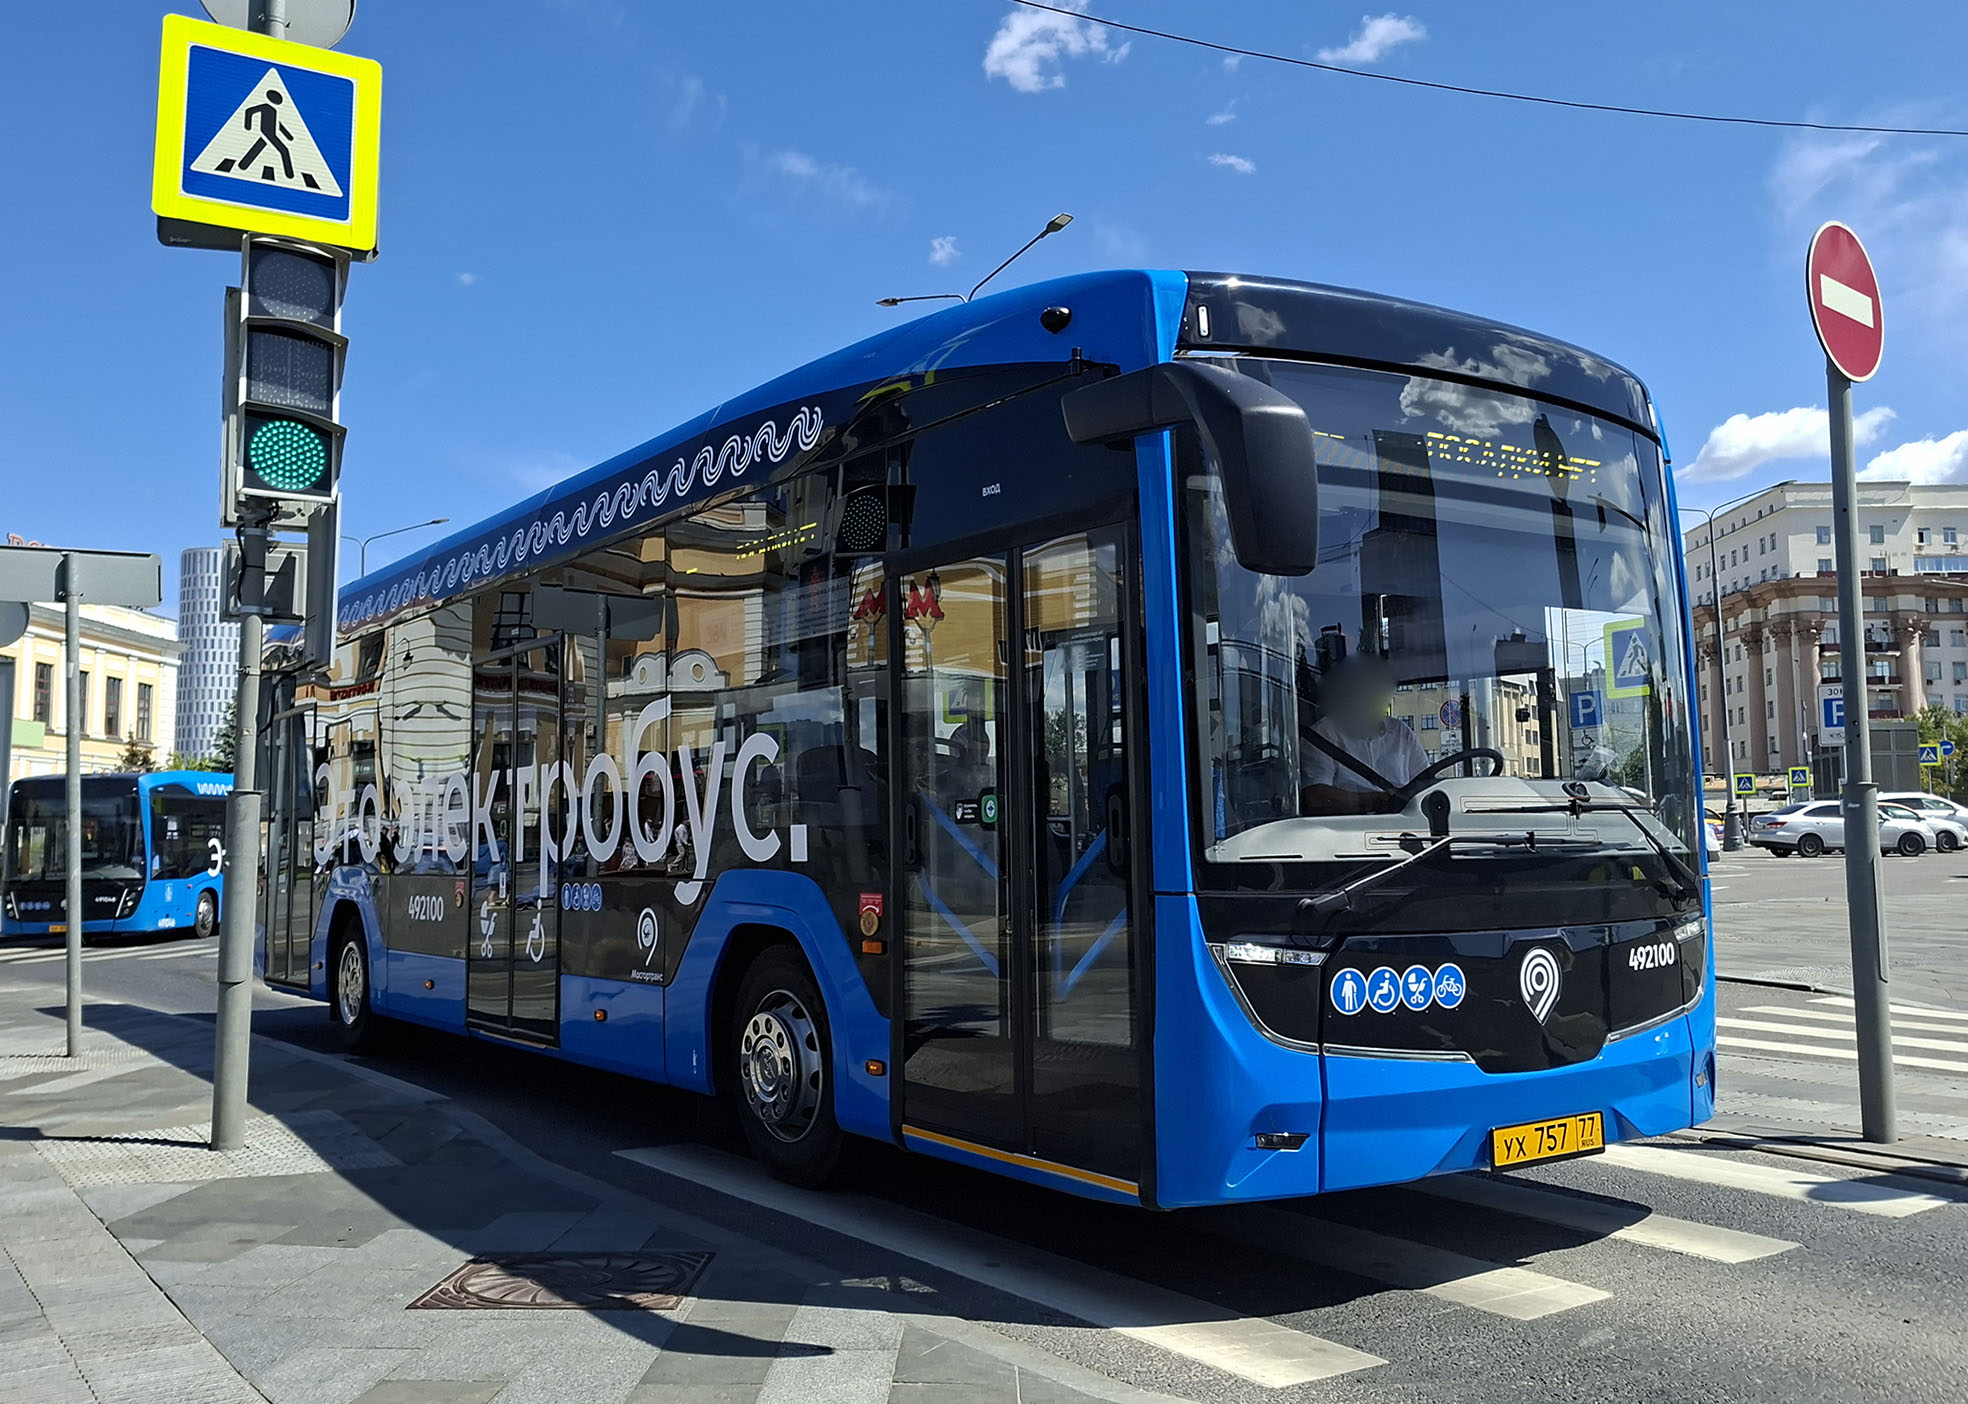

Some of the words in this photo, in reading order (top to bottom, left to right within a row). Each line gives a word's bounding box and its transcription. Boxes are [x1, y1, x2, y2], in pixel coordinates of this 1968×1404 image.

[982, 483, 1001, 496] ВХОД
[1576, 694, 1597, 724] P
[314, 762, 383, 866] Это
[393, 693, 808, 905] электробус.
[408, 895, 444, 922] 492100
[1628, 941, 1675, 971] 492100
[1534, 1122, 1568, 1154] 757
[1578, 1116, 1595, 1139] 77
[1581, 1138, 1595, 1147] RUS
